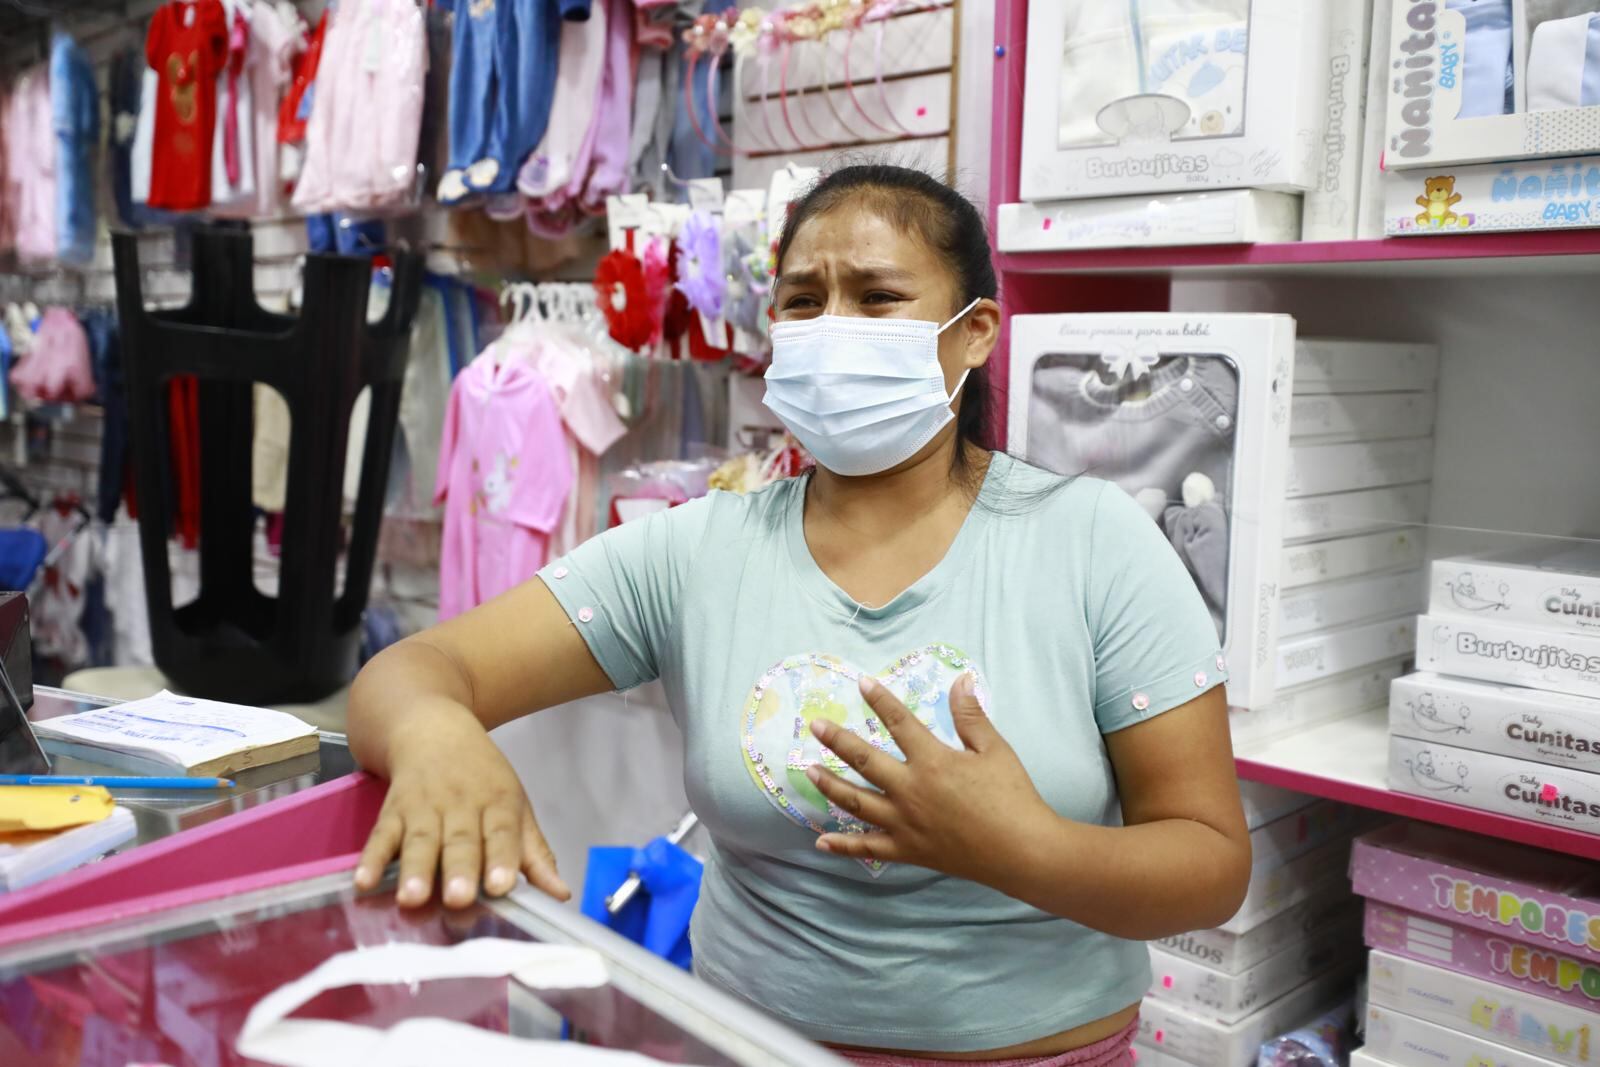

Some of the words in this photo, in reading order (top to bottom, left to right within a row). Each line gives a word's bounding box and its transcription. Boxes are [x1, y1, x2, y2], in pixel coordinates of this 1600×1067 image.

[1391, 0, 1437, 158] Ñañita
[1439, 43, 1459, 89] BABY
[1324, 54, 1350, 193] Burbujitas
[1086, 154, 1209, 179] Burbujitas
[1542, 199, 1591, 221] BABY
[1457, 632, 1600, 673] Burbujitas
[1507, 723, 1600, 755] Cunitas
[1429, 874, 1600, 951] TEMPORES
[1487, 938, 1600, 1000] TEMPO
